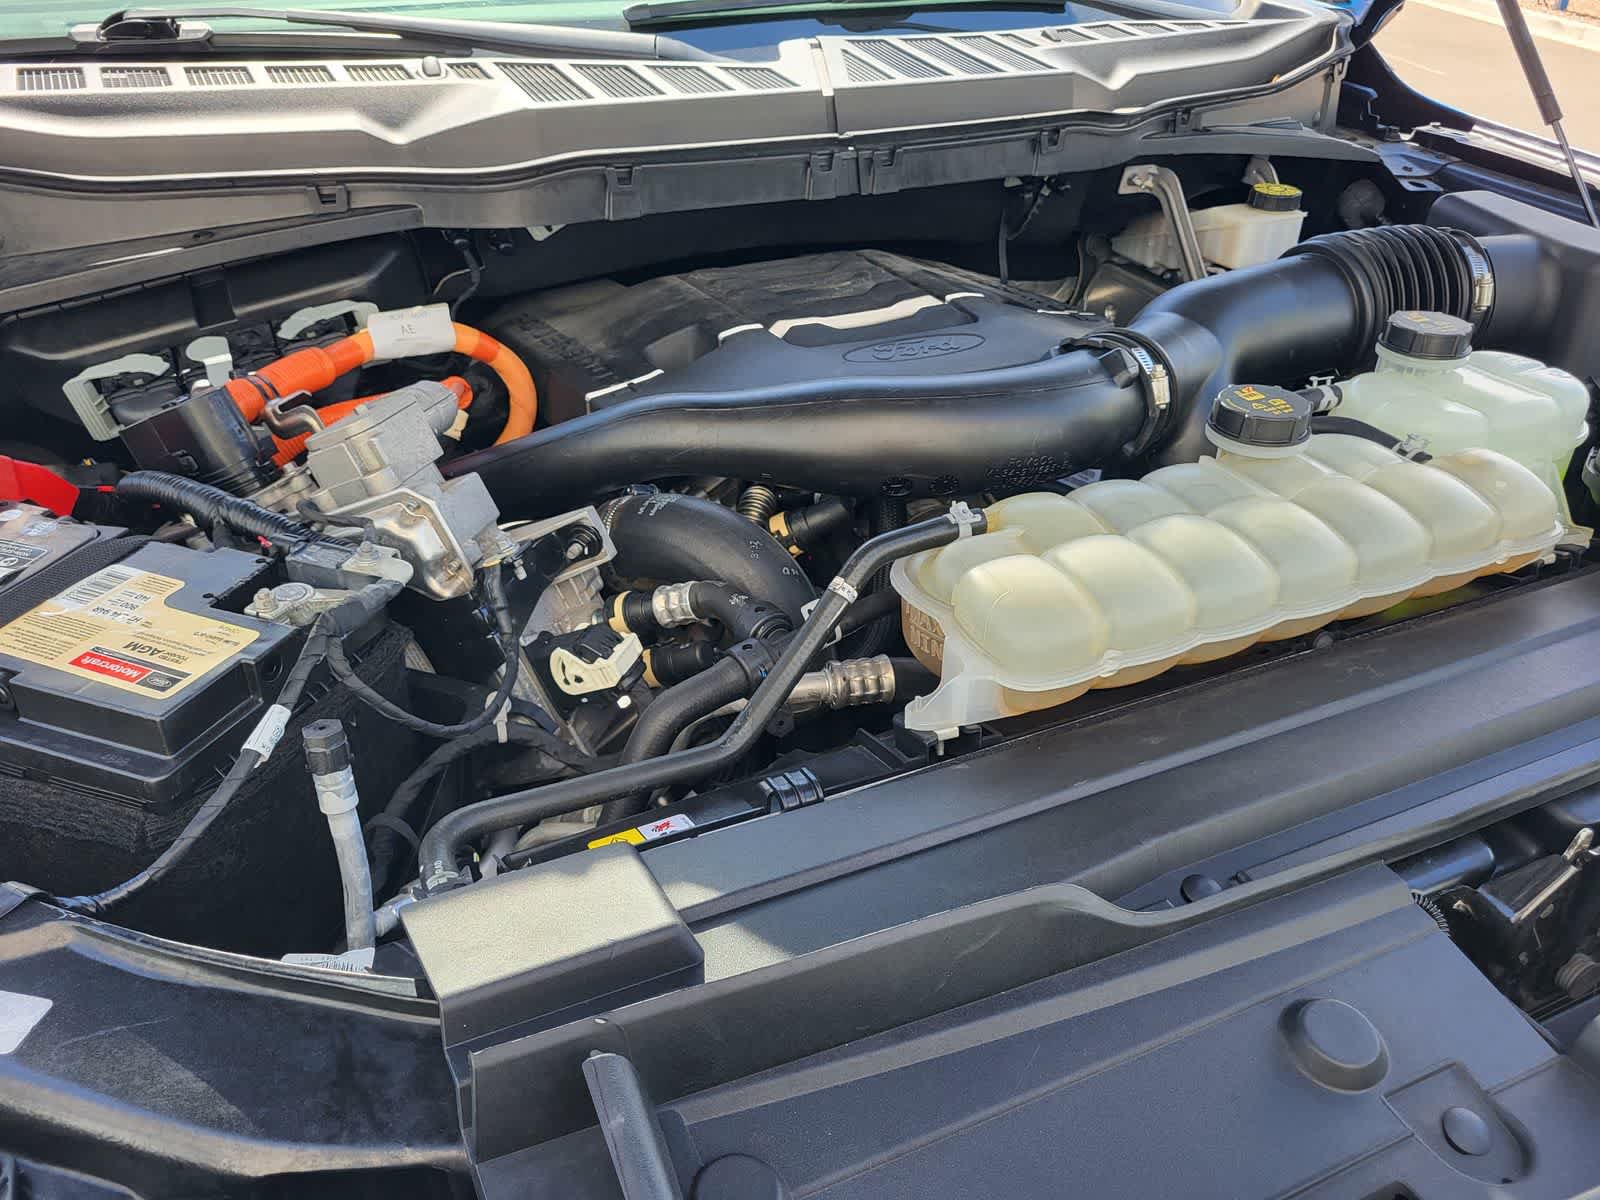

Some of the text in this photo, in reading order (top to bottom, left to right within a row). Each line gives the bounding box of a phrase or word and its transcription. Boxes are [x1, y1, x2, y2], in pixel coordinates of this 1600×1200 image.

[871, 336, 961, 361] Ford
[122, 640, 164, 658] AGM
[81, 654, 143, 679] Motorcraft
